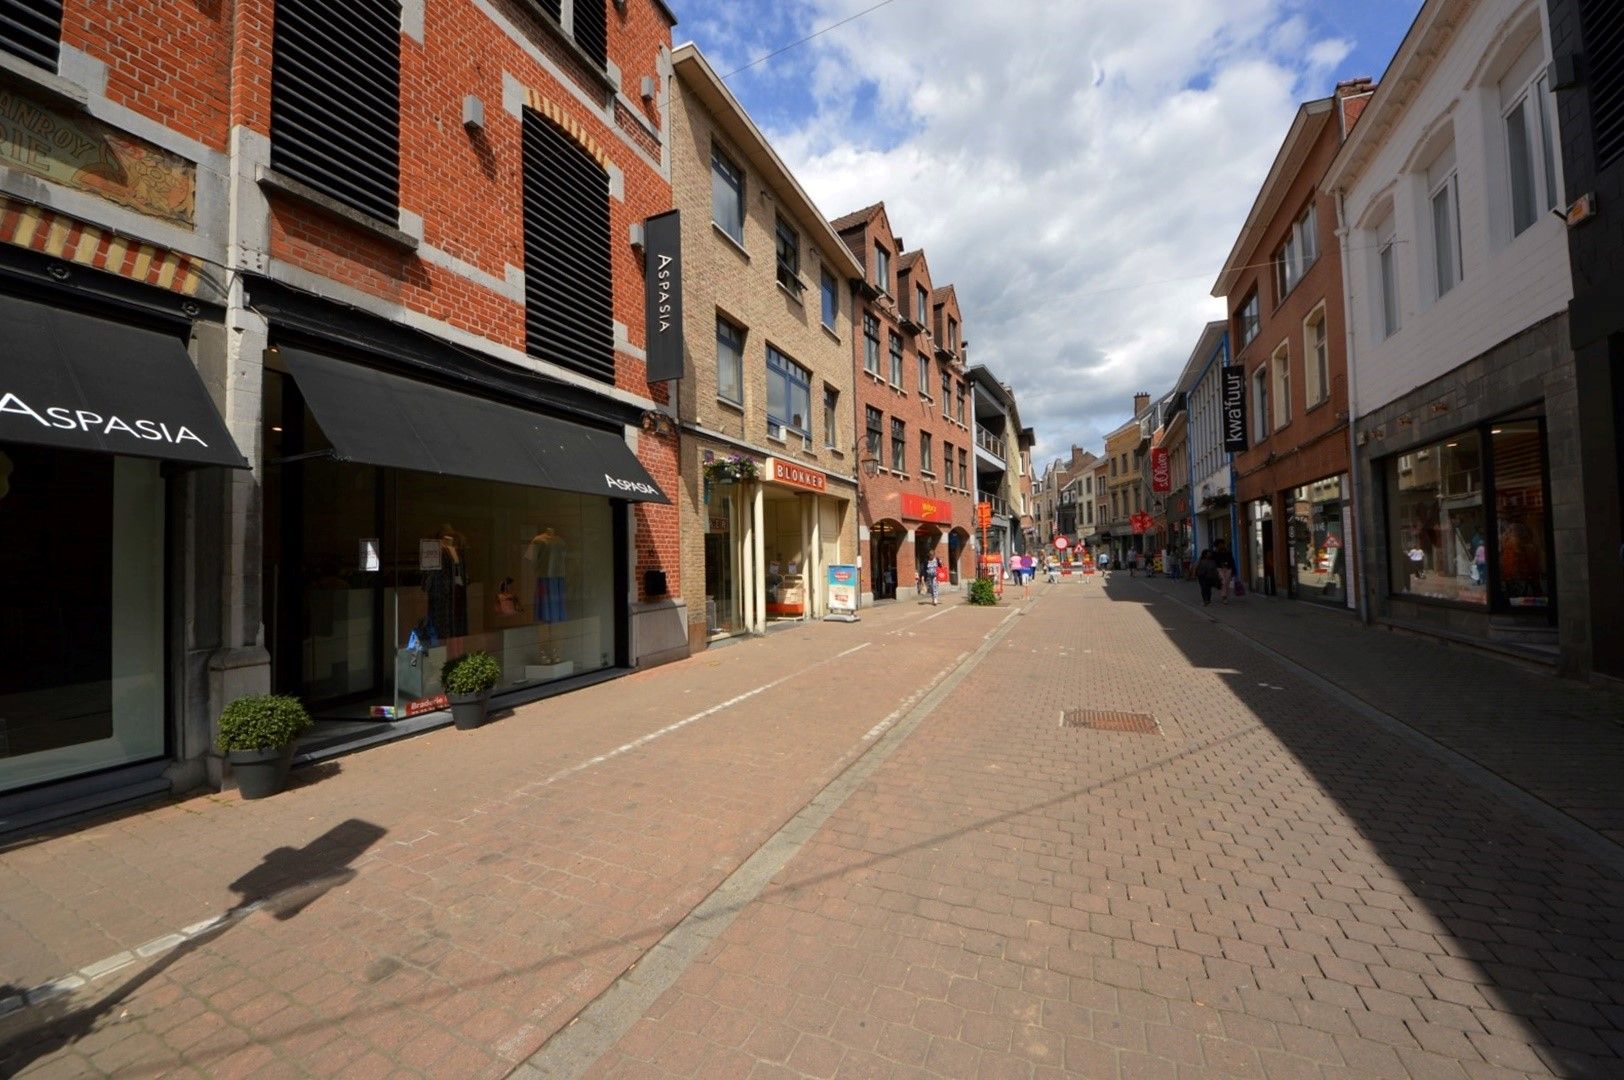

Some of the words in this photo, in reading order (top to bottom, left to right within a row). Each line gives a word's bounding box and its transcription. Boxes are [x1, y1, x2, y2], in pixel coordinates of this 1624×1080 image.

[657, 254, 673, 332] ASPASIA
[0, 392, 209, 447] ASPASIA
[1224, 373, 1243, 442] kwa'fuur
[604, 473, 659, 496] ASPASIA
[776, 464, 823, 489] BLOKKER
